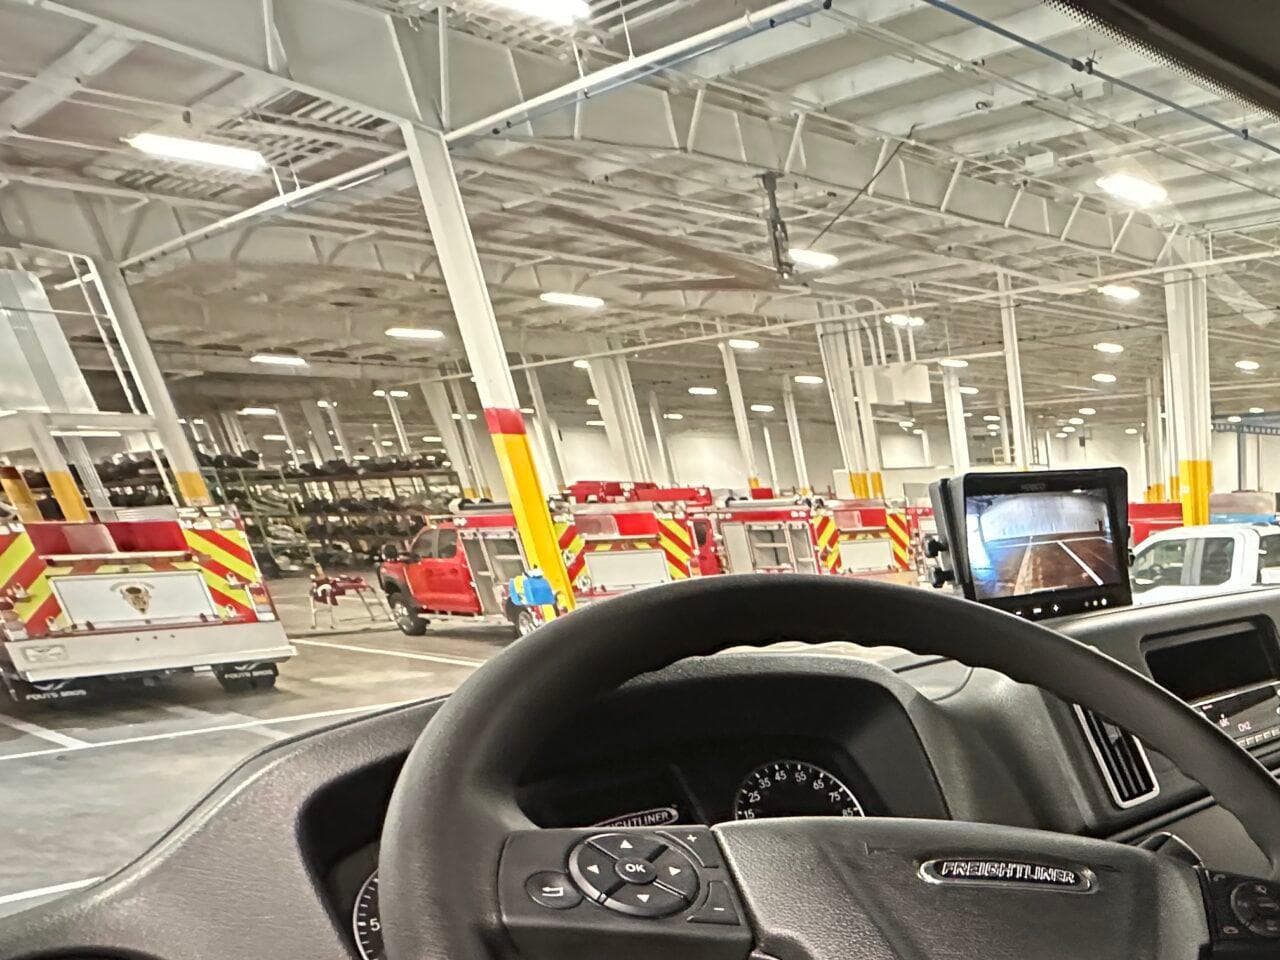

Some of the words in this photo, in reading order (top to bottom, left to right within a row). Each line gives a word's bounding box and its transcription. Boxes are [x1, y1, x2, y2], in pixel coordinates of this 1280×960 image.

[775, 770, 787, 781] 45
[795, 771, 807, 782] 55
[758, 777, 771, 789] 35
[813, 780, 825, 790] 65
[748, 790, 761, 803] 25
[829, 791, 841, 803] 75
[743, 810, 755, 819] 15
[625, 864, 647, 873] OK
[941, 861, 1076, 885] FREIGHTLINER
